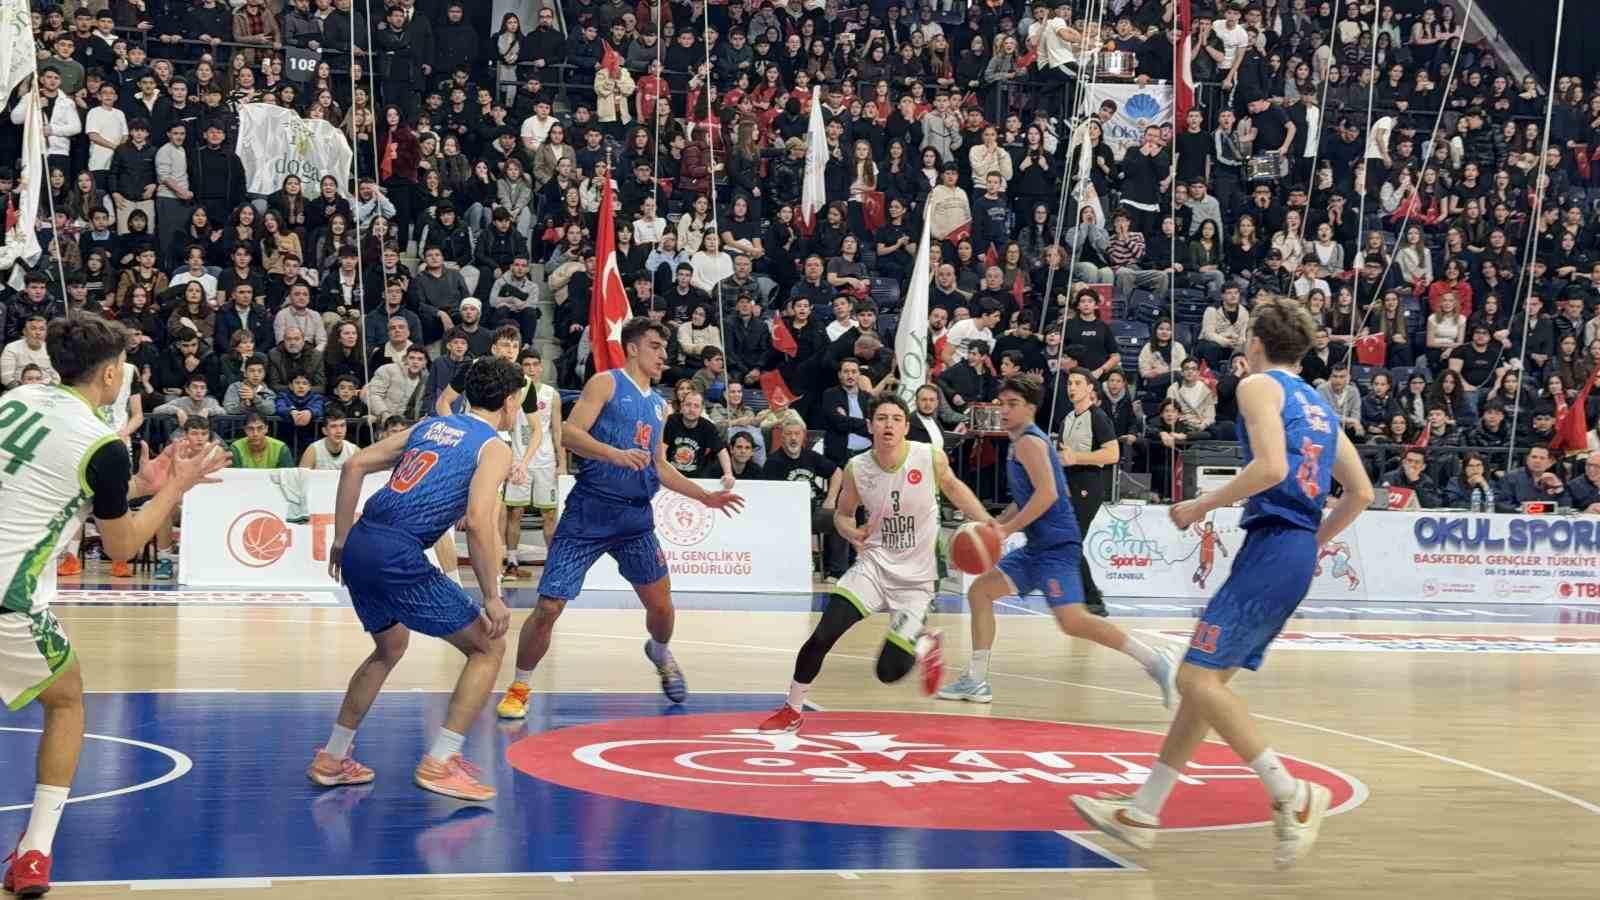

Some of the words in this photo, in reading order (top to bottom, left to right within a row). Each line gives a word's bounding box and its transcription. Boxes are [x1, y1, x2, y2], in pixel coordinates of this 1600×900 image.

[289, 58, 317, 72] 108
[891, 490, 900, 512] 3
[1414, 517, 1504, 550] OKUL
[682, 548, 733, 563] GENÇLİK
[735, 551, 751, 562] VE
[1414, 554, 1482, 565] BASKETBOL
[1486, 555, 1542, 567] GENÇLER
[671, 562, 751, 575] MÜDÜRLÜĞÜ
